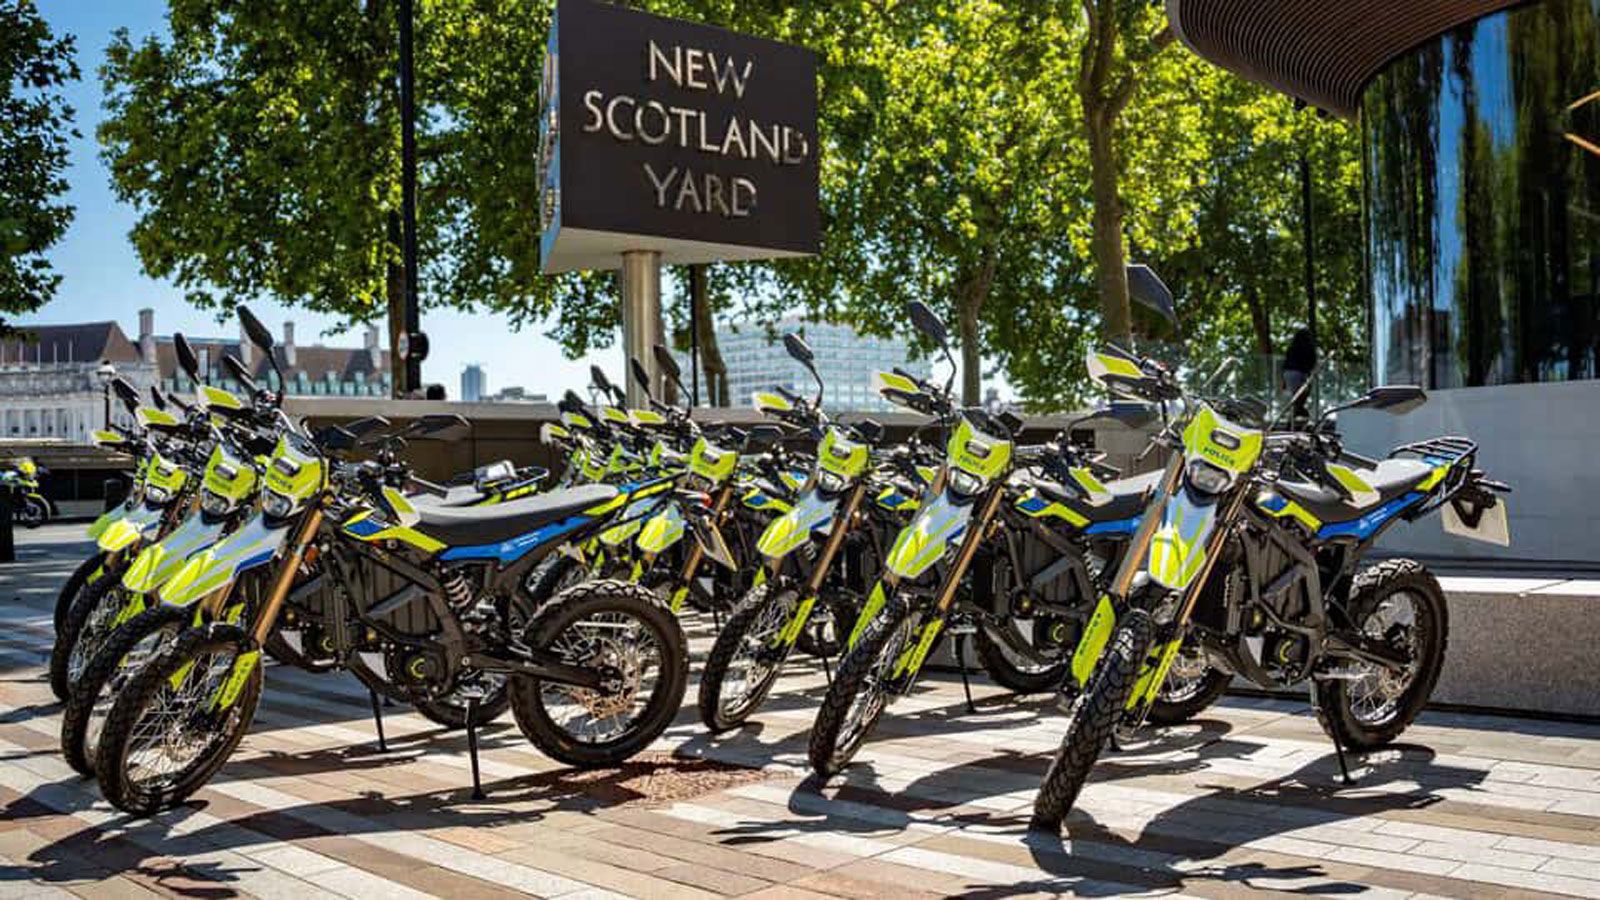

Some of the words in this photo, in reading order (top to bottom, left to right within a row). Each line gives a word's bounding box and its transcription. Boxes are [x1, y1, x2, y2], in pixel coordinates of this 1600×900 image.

[649, 39, 753, 98] NEW
[583, 90, 808, 164] SCOTLAND
[644, 163, 757, 217] YARD
[1203, 445, 1236, 467] POLICE
